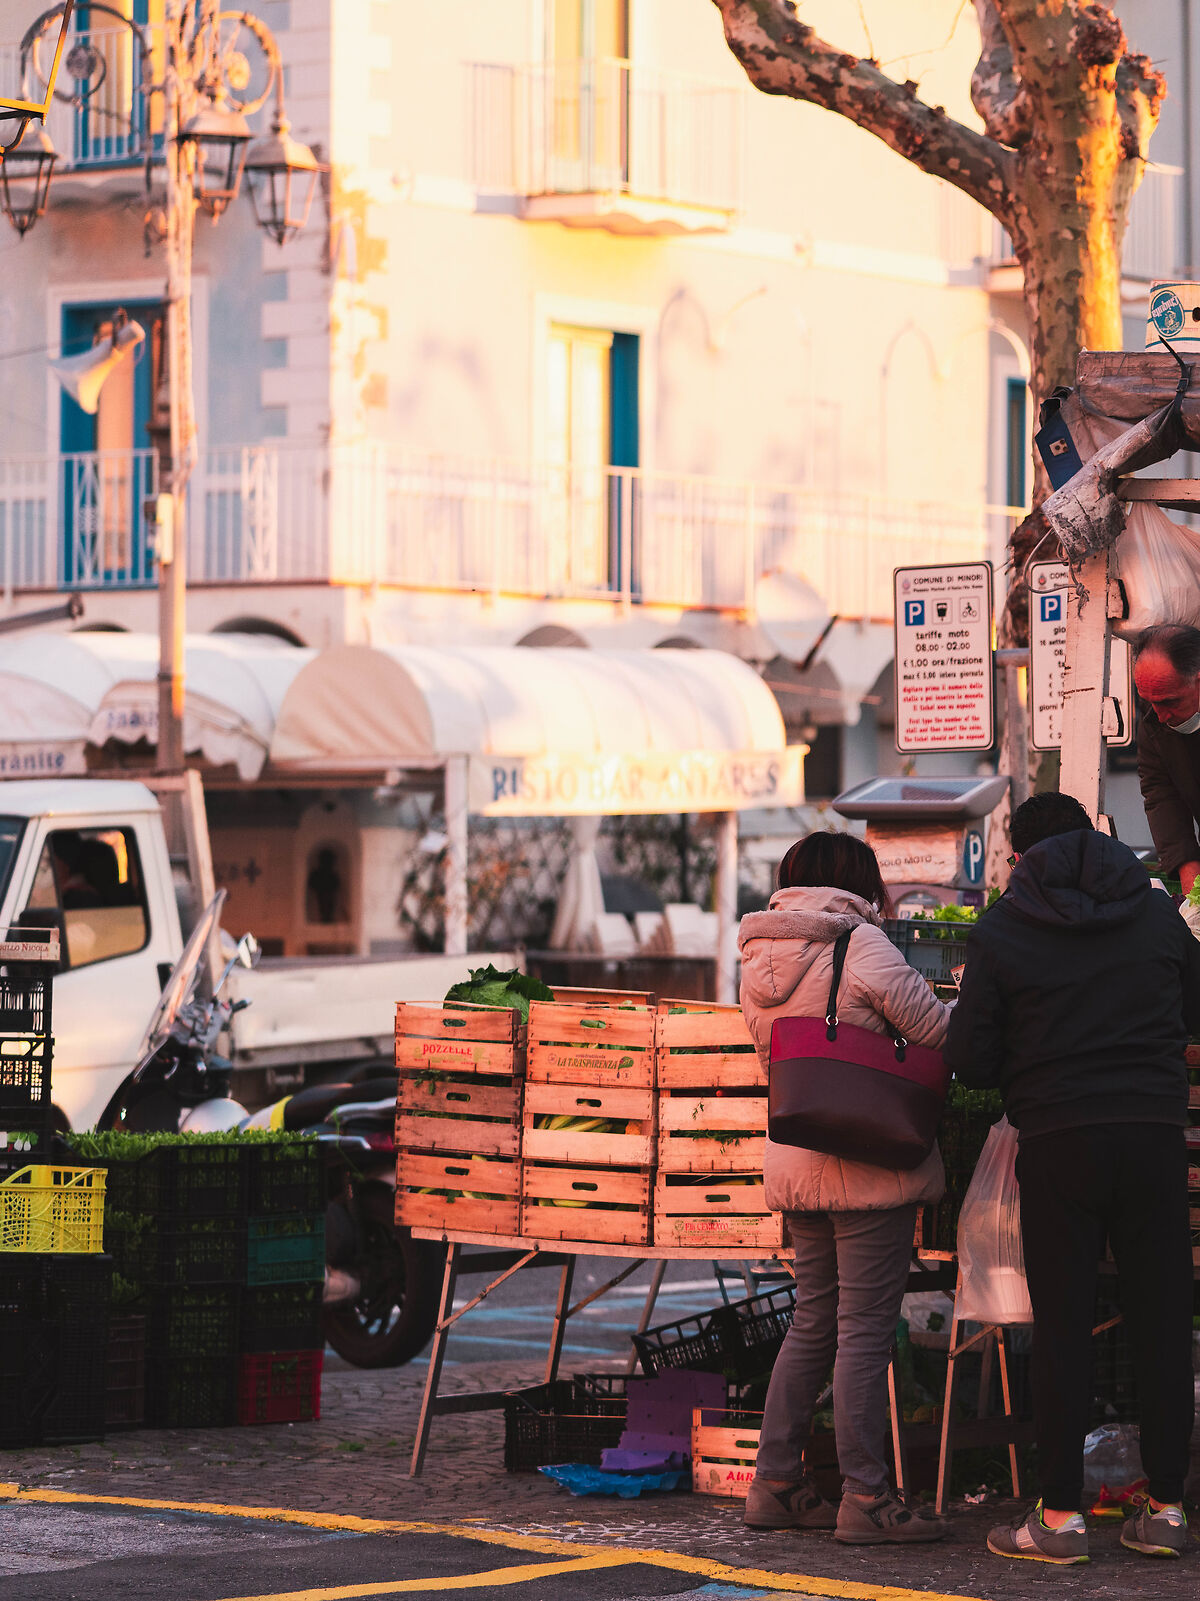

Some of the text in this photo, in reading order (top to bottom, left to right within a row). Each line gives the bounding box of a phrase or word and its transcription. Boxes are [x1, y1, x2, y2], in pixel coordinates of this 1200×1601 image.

[1152, 296, 1179, 318] Chiquita
[913, 576, 942, 585] COMUNE
[916, 630, 970, 640] tariffe moto
[492, 765, 578, 801] RISTO
[591, 765, 646, 801] BAR
[879, 855, 932, 867] SOLO MOTO
[422, 1043, 472, 1056] POZZELLE
[568, 1057, 618, 1070] TRASPARENZA
